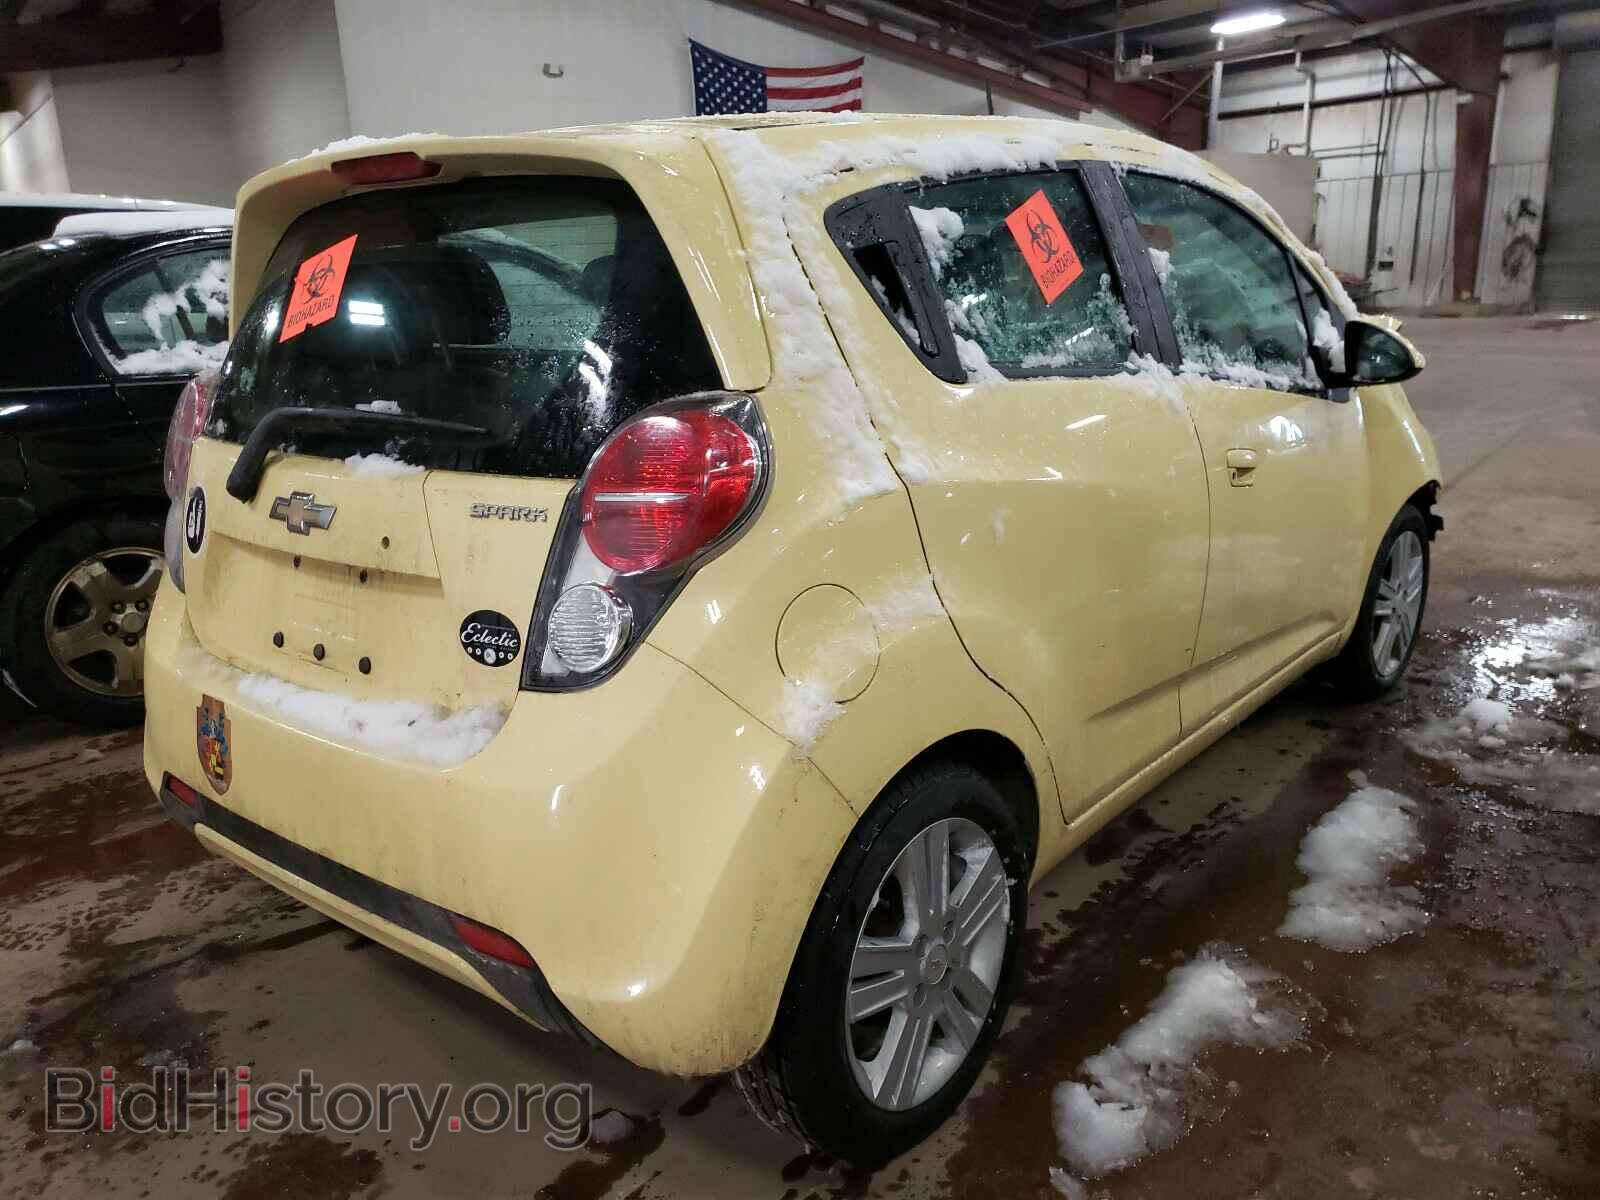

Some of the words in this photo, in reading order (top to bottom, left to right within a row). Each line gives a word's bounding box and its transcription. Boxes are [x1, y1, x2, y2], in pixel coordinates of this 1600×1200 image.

[1041, 250, 1076, 289] BIOHAZARD
[286, 294, 336, 328] BIOHAZARD
[470, 503, 549, 522] SPARK
[460, 622, 519, 648] Eclectic
